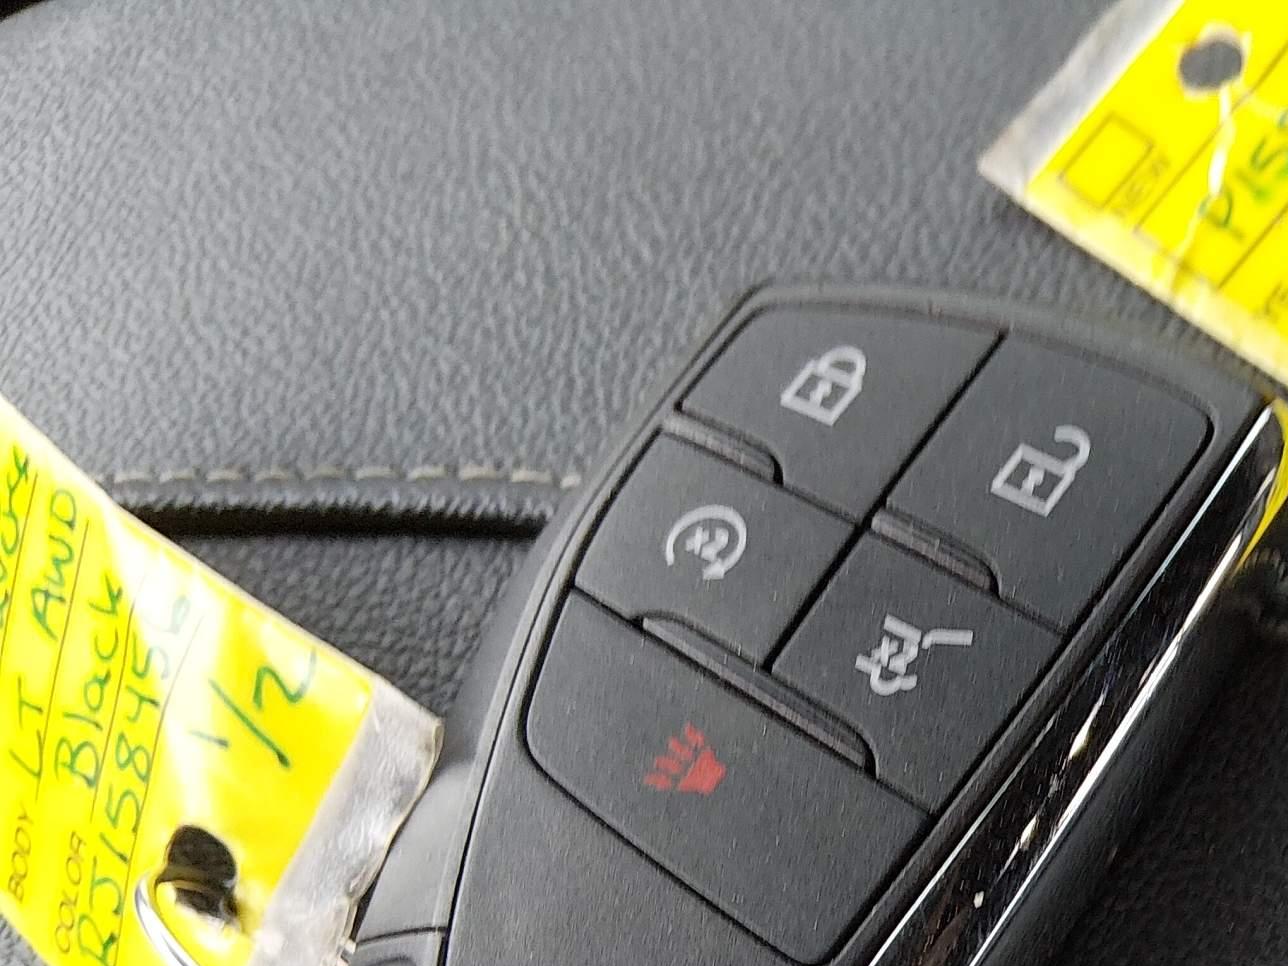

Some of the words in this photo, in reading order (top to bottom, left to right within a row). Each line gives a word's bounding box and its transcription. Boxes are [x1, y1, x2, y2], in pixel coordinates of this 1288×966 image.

[9, 676, 43, 780] LT
[31, 489, 77, 642] AWD
[54, 571, 123, 790] Black
[190, 648, 317, 770] 1/2
[8, 803, 33, 903] BODY
[54, 831, 86, 954] COLOR
